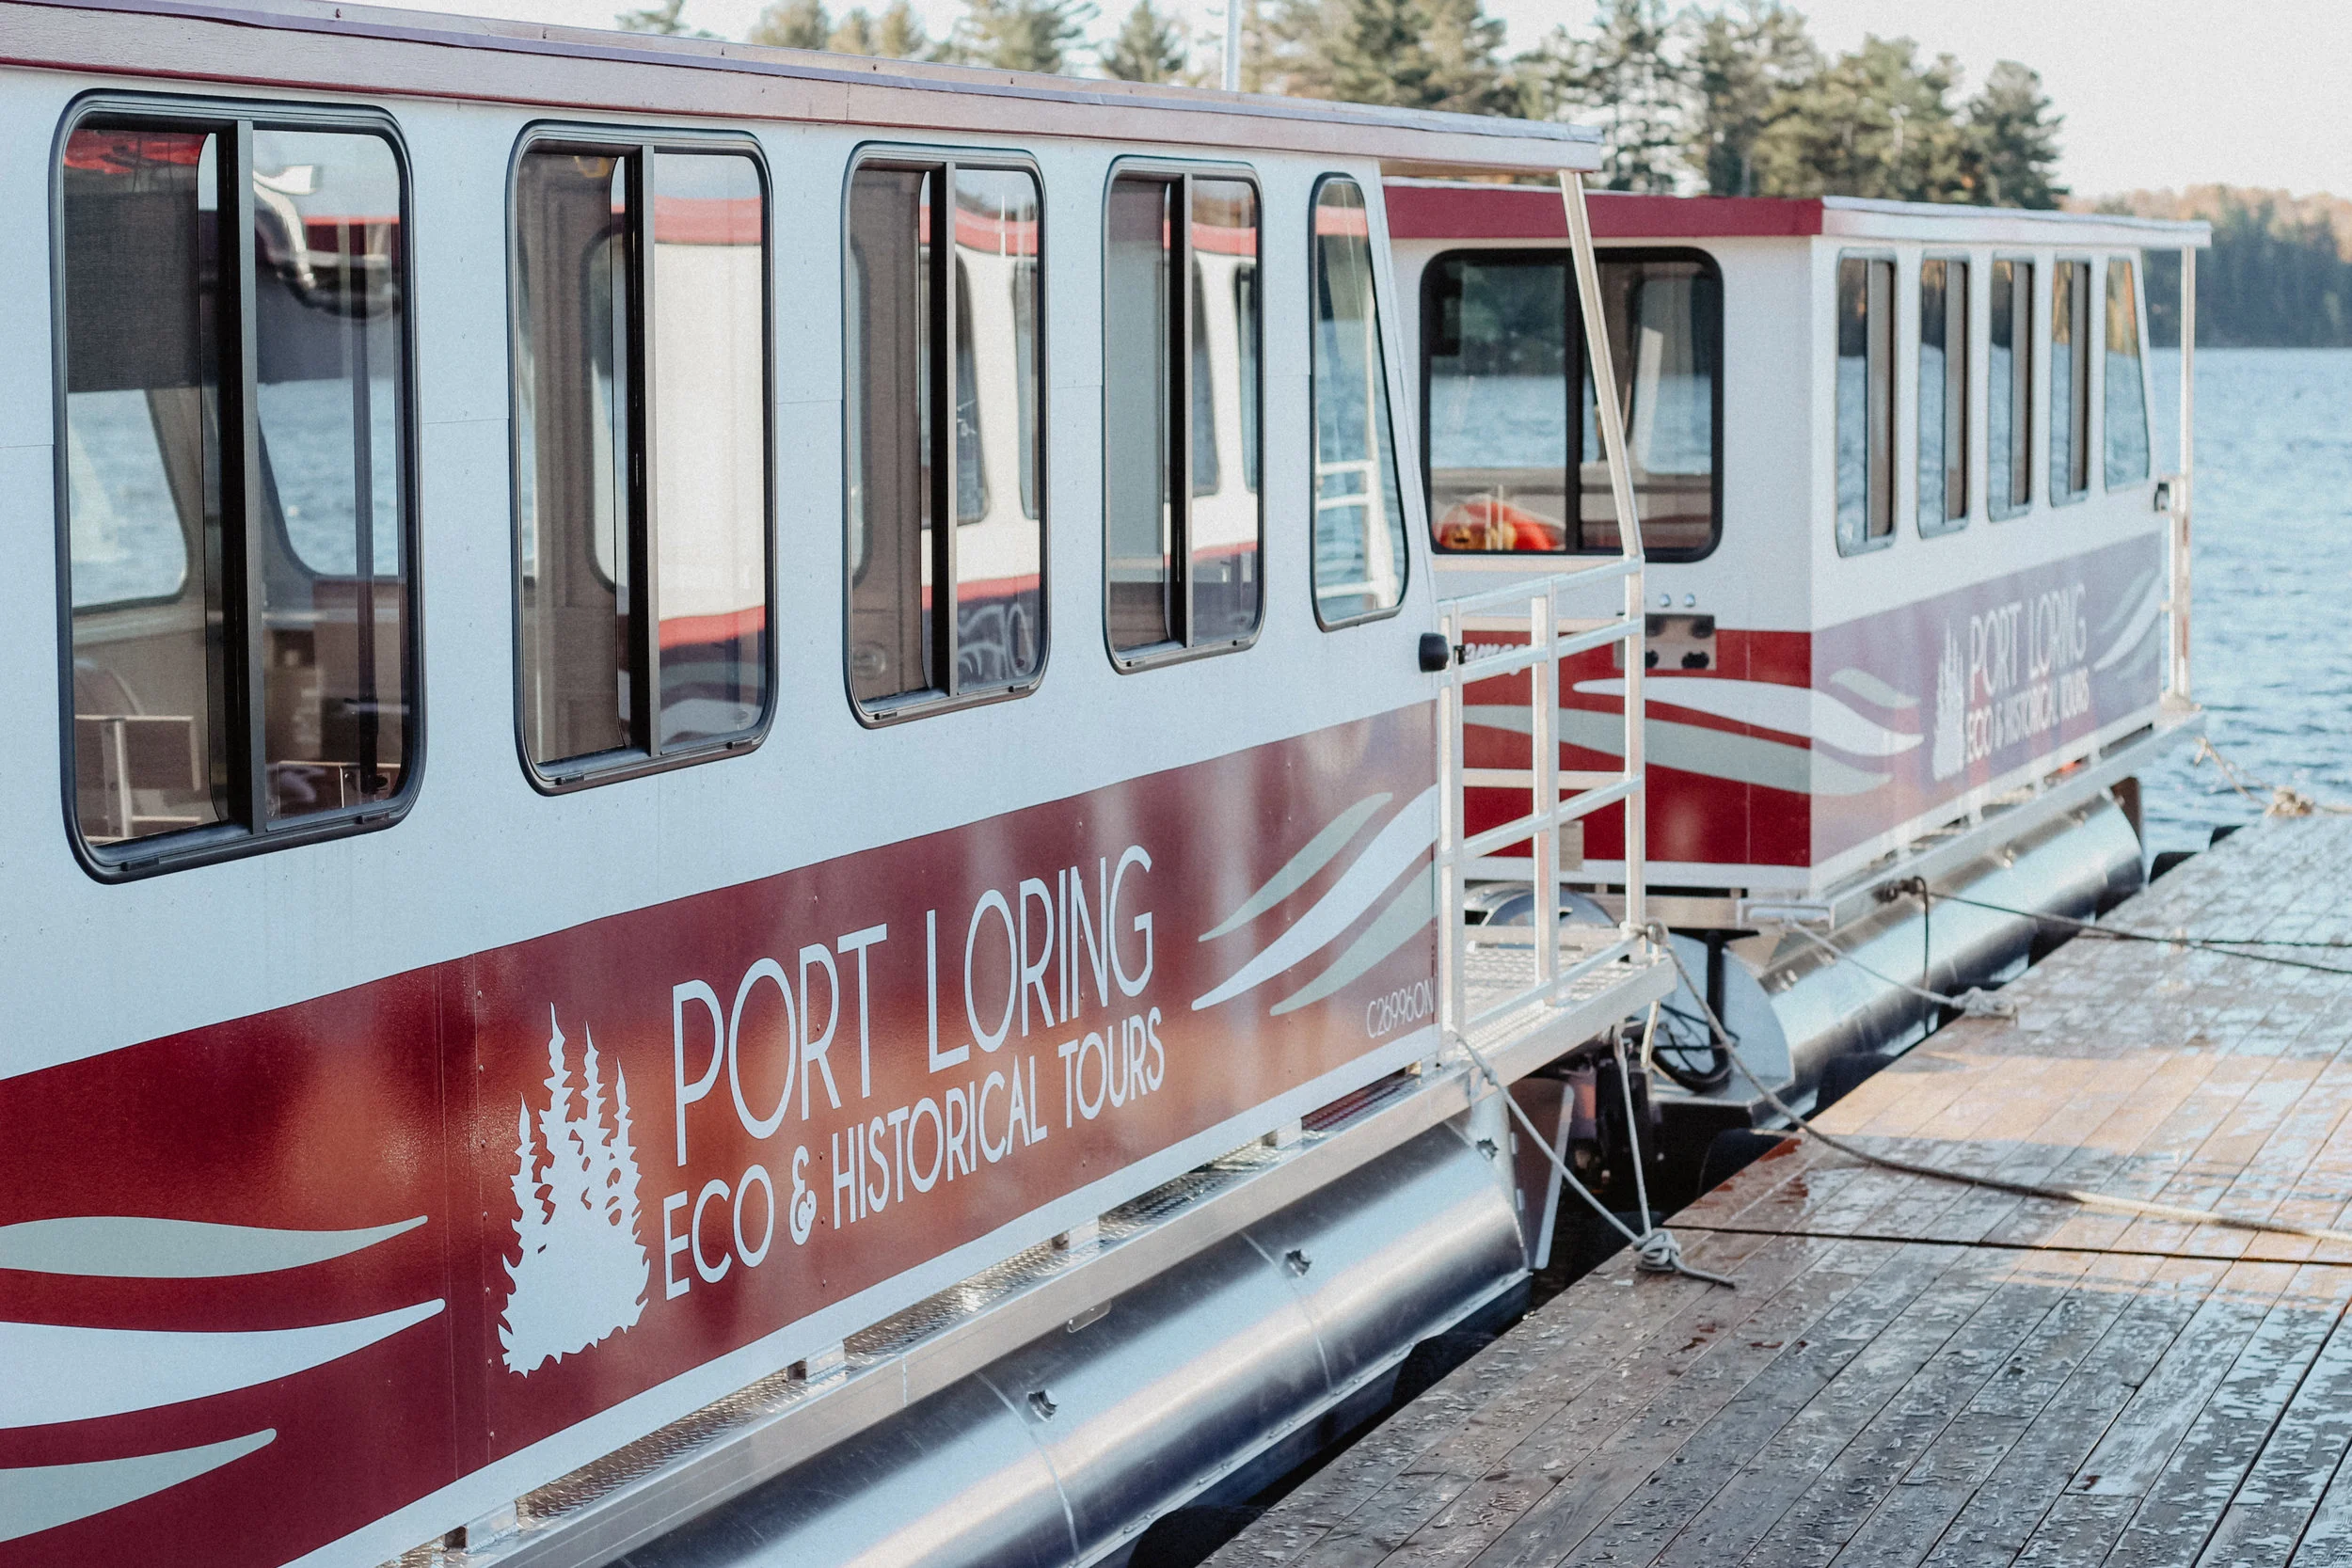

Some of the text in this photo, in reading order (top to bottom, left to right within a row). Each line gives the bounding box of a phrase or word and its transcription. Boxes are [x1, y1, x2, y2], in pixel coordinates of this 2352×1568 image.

[1970, 602, 2022, 703] PORT
[673, 845, 1153, 1166] PORT LORING
[663, 1006, 1166, 1301] ECO & HISTORICAL TOURS
